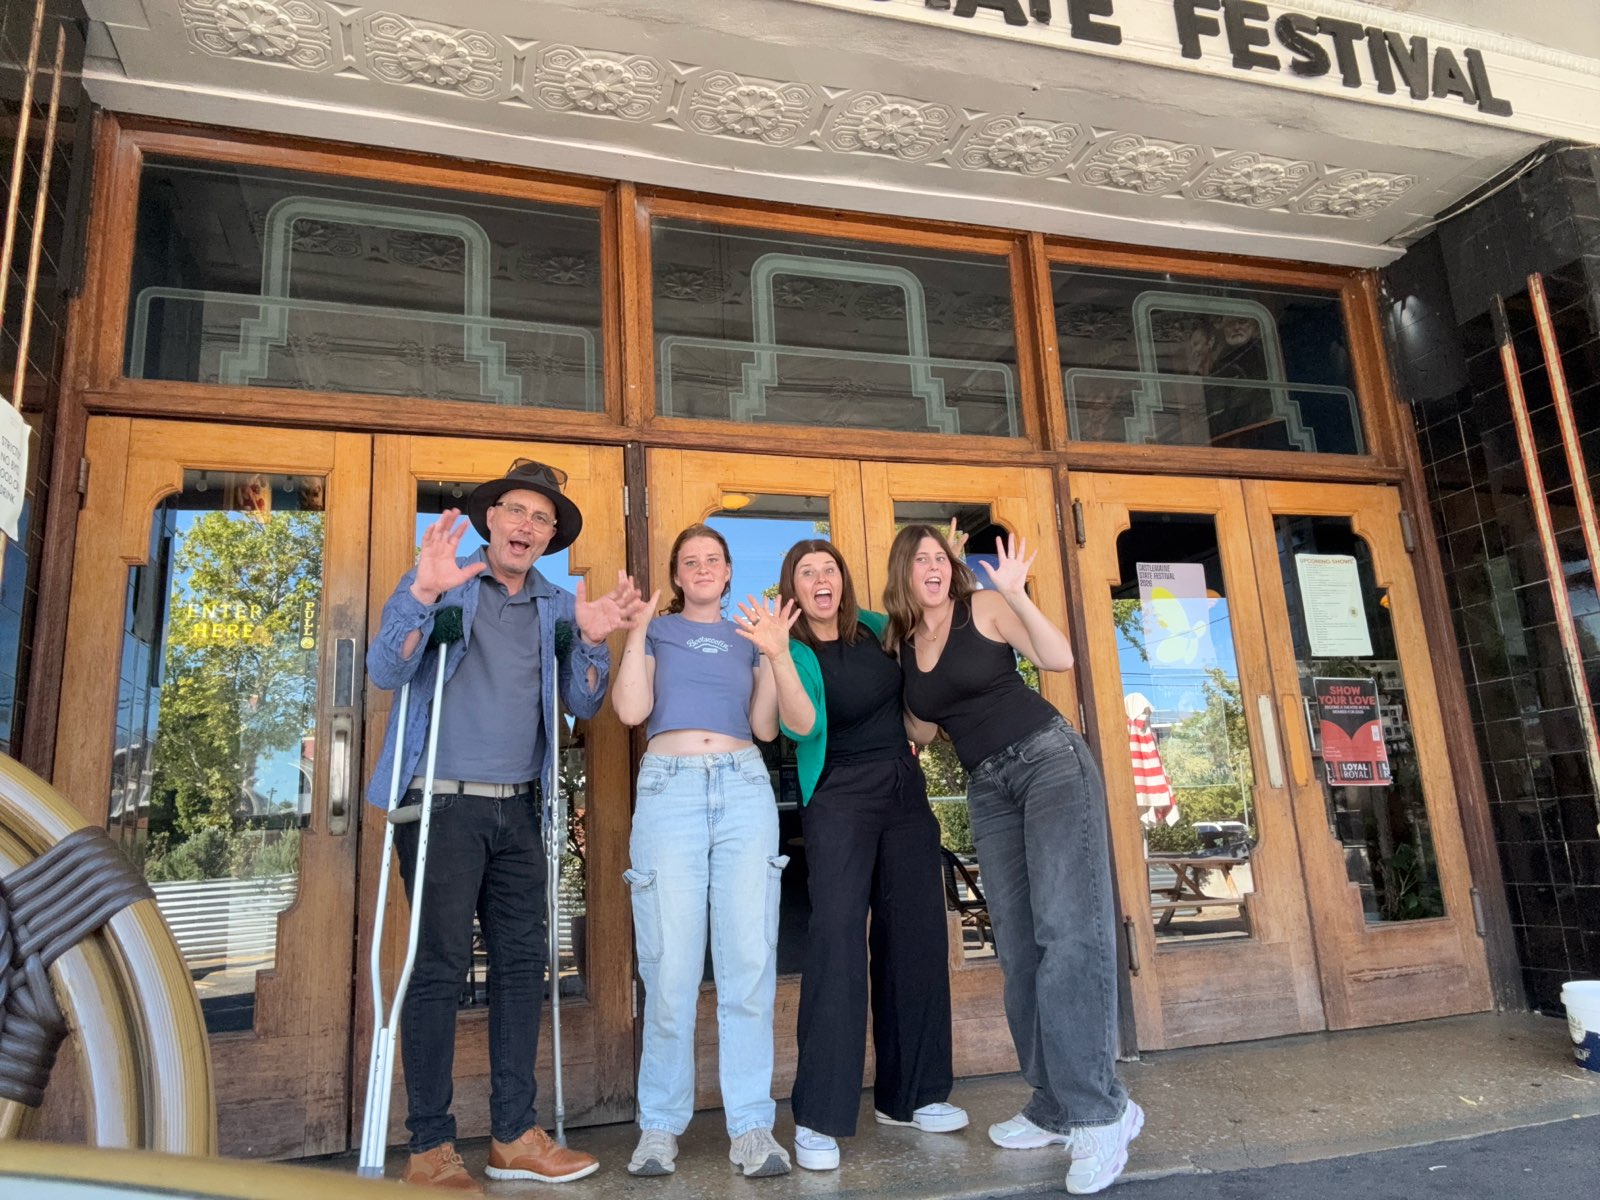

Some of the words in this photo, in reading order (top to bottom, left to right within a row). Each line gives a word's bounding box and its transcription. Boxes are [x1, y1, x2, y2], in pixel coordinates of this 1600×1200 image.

[1175, 0, 1513, 117] FESTIVAL
[1154, 572, 1175, 580] FESTIVAL
[1140, 579, 1153, 587] 2026
[186, 603, 262, 621] ENTER
[303, 601, 316, 637] PULL
[192, 623, 254, 639] HERE
[1330, 686, 1361, 695] SHOW
[1319, 695, 1347, 705] YOUR
[1348, 695, 1376, 705] LOVE
[1342, 763, 1368, 771] LOYAL
[1344, 770, 1369, 779] ROYAL
